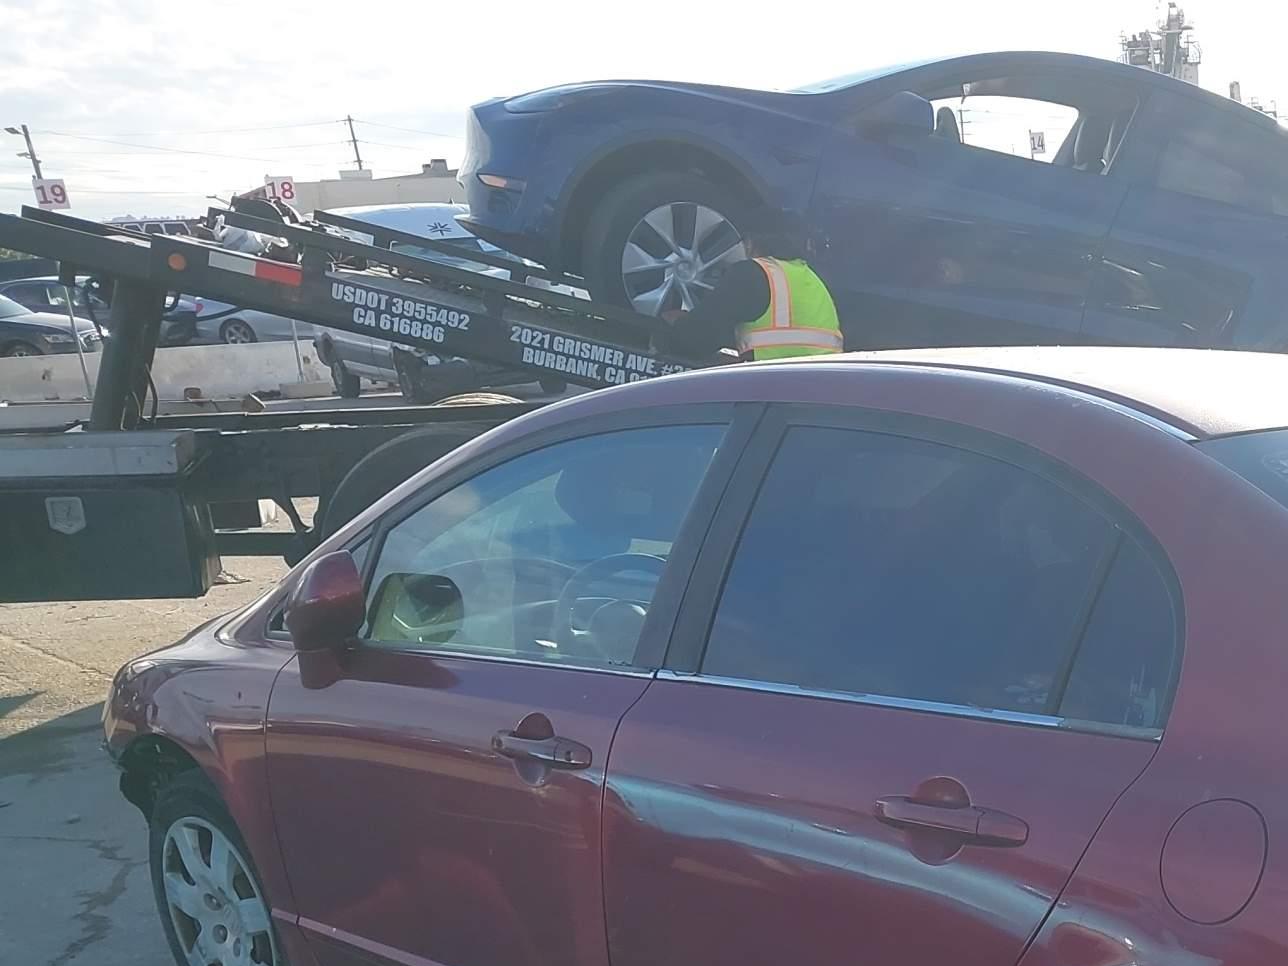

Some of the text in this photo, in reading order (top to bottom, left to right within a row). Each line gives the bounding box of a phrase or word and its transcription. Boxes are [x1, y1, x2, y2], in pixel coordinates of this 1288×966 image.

[1031, 135, 1044, 151] 14
[36, 184, 67, 205] 19
[267, 182, 295, 201] 18
[331, 283, 470, 330] USDOT 3955492
[353, 307, 445, 343] CA 616886
[510, 326, 550, 349] 2021
[552, 336, 623, 367] GRISMER
[522, 347, 600, 380] BURBANK,
[604, 367, 626, 384] CA
